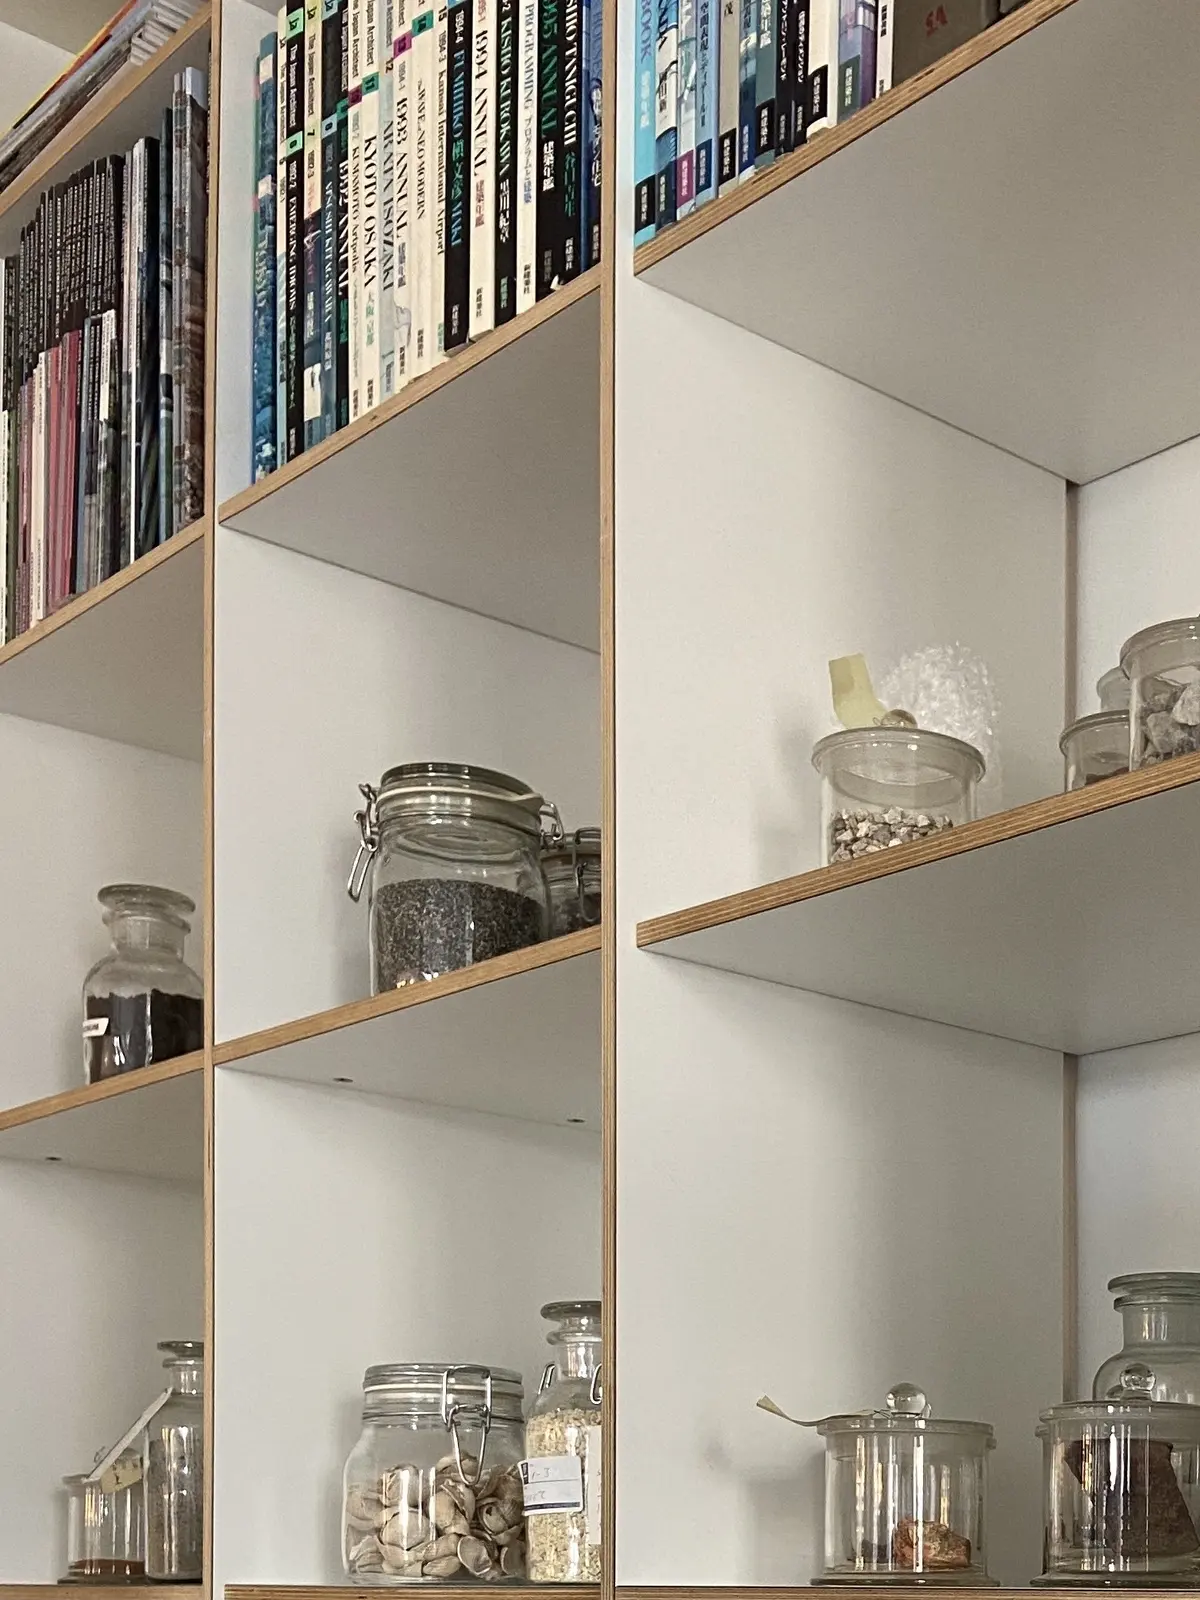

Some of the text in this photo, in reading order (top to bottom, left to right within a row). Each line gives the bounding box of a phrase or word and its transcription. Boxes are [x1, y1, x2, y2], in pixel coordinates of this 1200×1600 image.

[500, 16, 513, 74] KISHO
[540, 44, 558, 139] ANNUAL
[474, 30, 489, 176] 1994 ANNUAL
[563, 42, 578, 147] TANIGUCHI
[364, 136, 378, 208] KYOTO
[396, 97, 408, 240] 1993 ANNUAL
[363, 216, 377, 287] OSAKA
